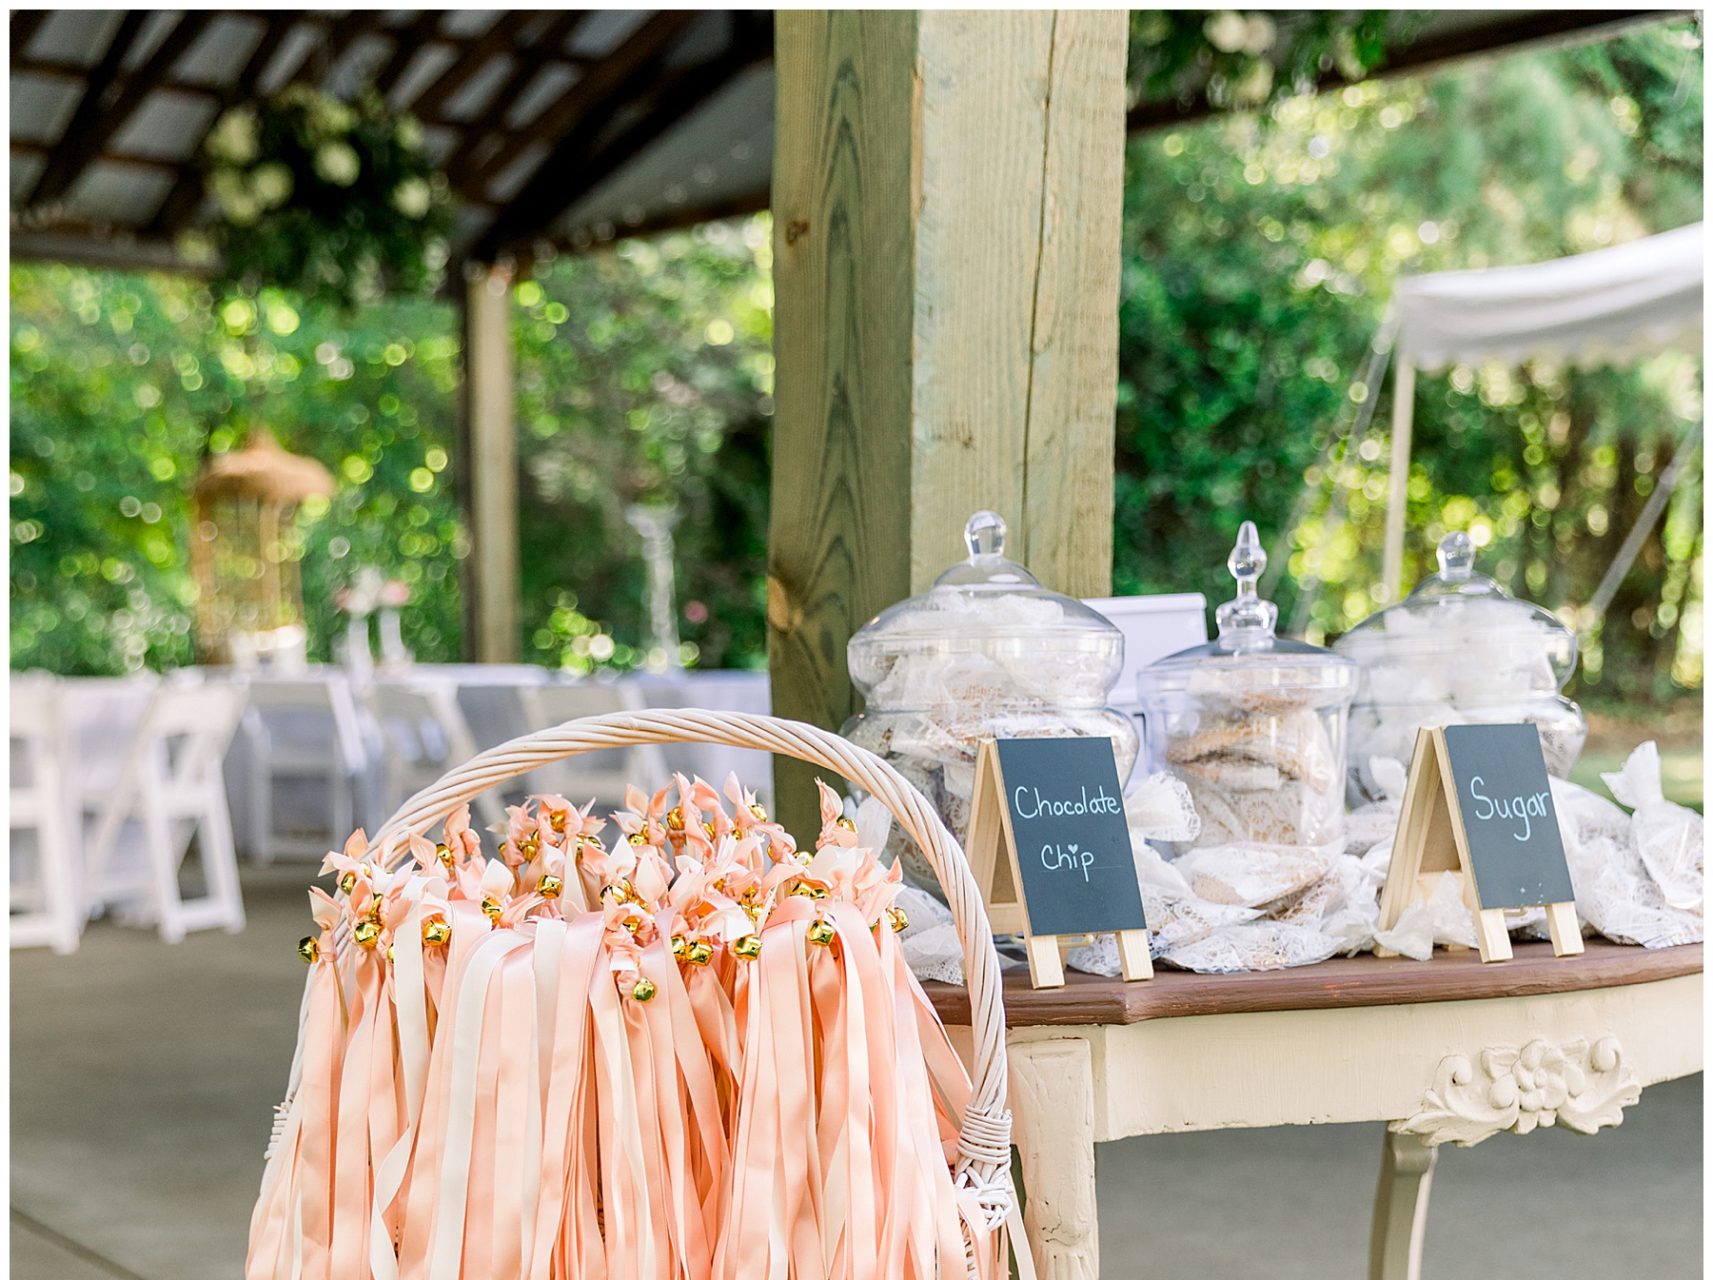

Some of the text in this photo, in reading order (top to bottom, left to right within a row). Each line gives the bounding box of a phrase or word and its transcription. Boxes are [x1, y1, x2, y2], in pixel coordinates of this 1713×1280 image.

[1014, 785, 1121, 819] Chocolate
[1470, 776, 1550, 841] Sugar
[1041, 844, 1095, 882] Chip
